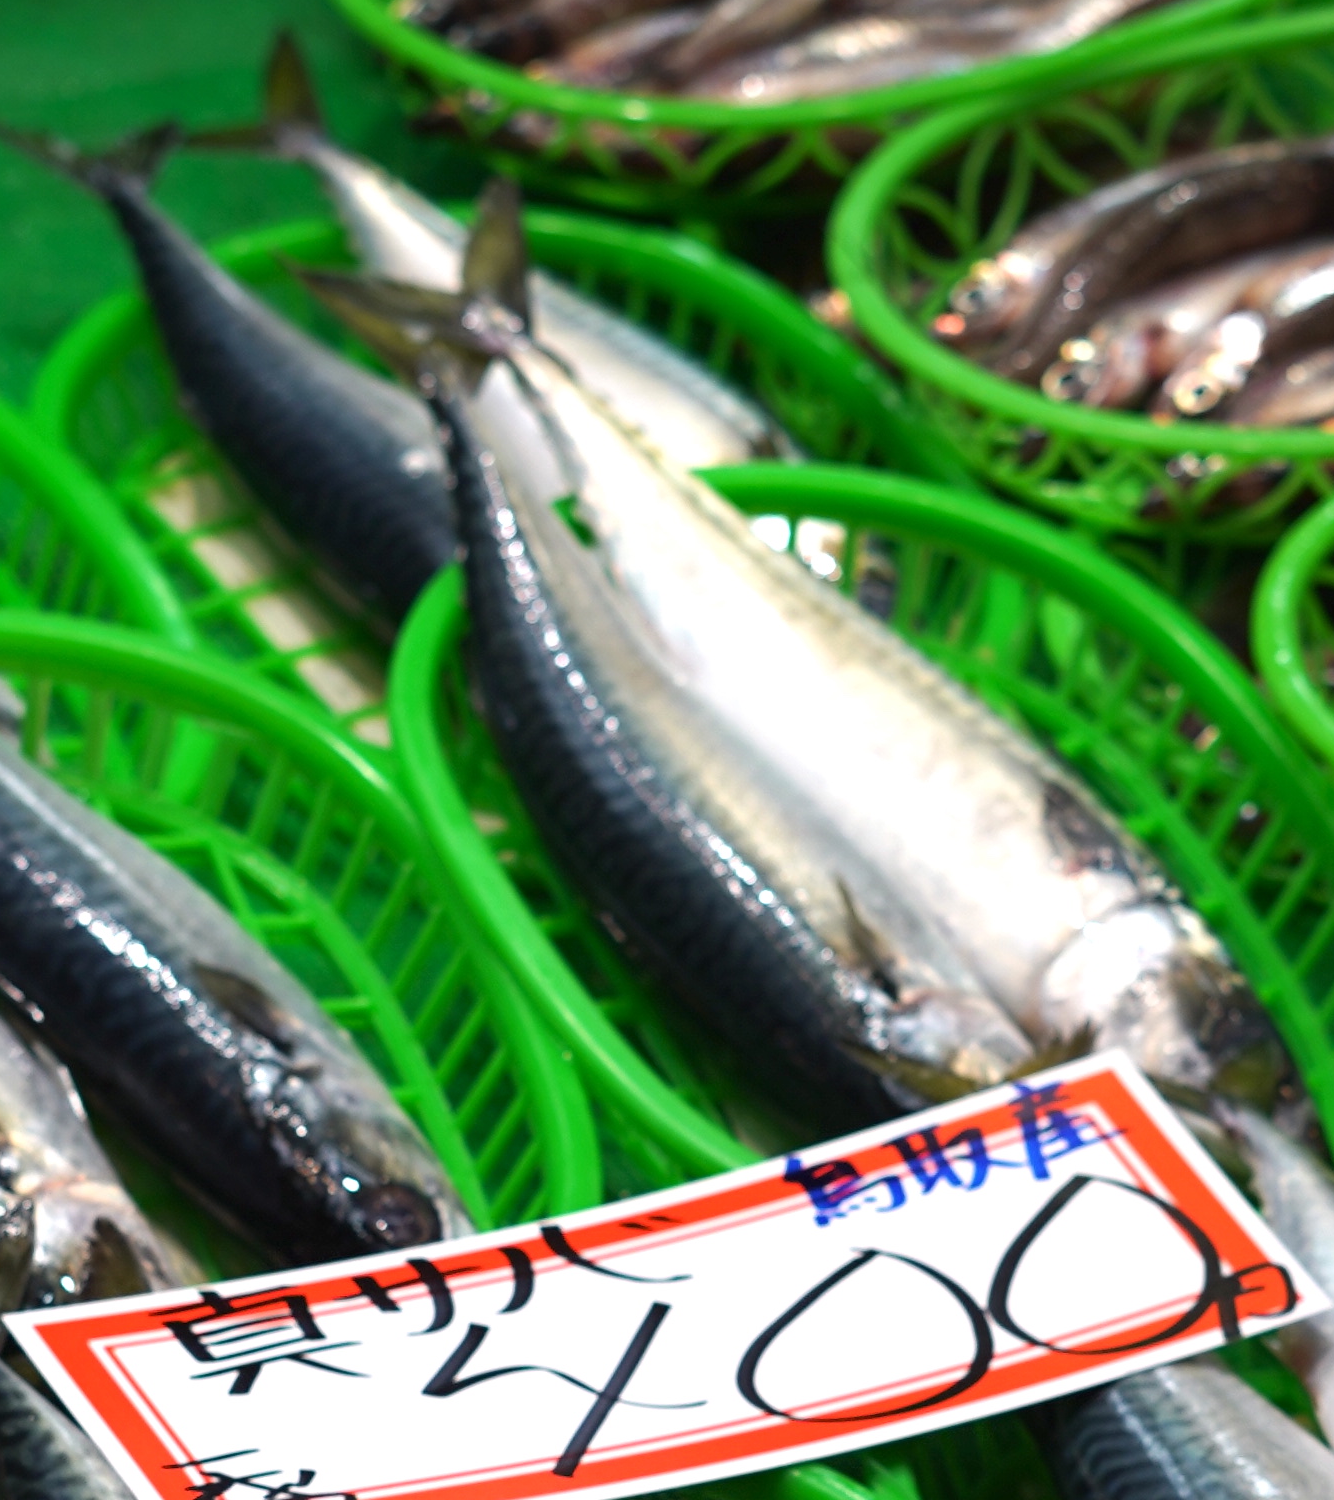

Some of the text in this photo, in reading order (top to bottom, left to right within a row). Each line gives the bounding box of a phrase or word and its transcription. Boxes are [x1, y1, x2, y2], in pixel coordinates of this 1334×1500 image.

[783, 1079, 1130, 1228] 鳥取産
[149, 1215, 693, 1395] 真サバ
